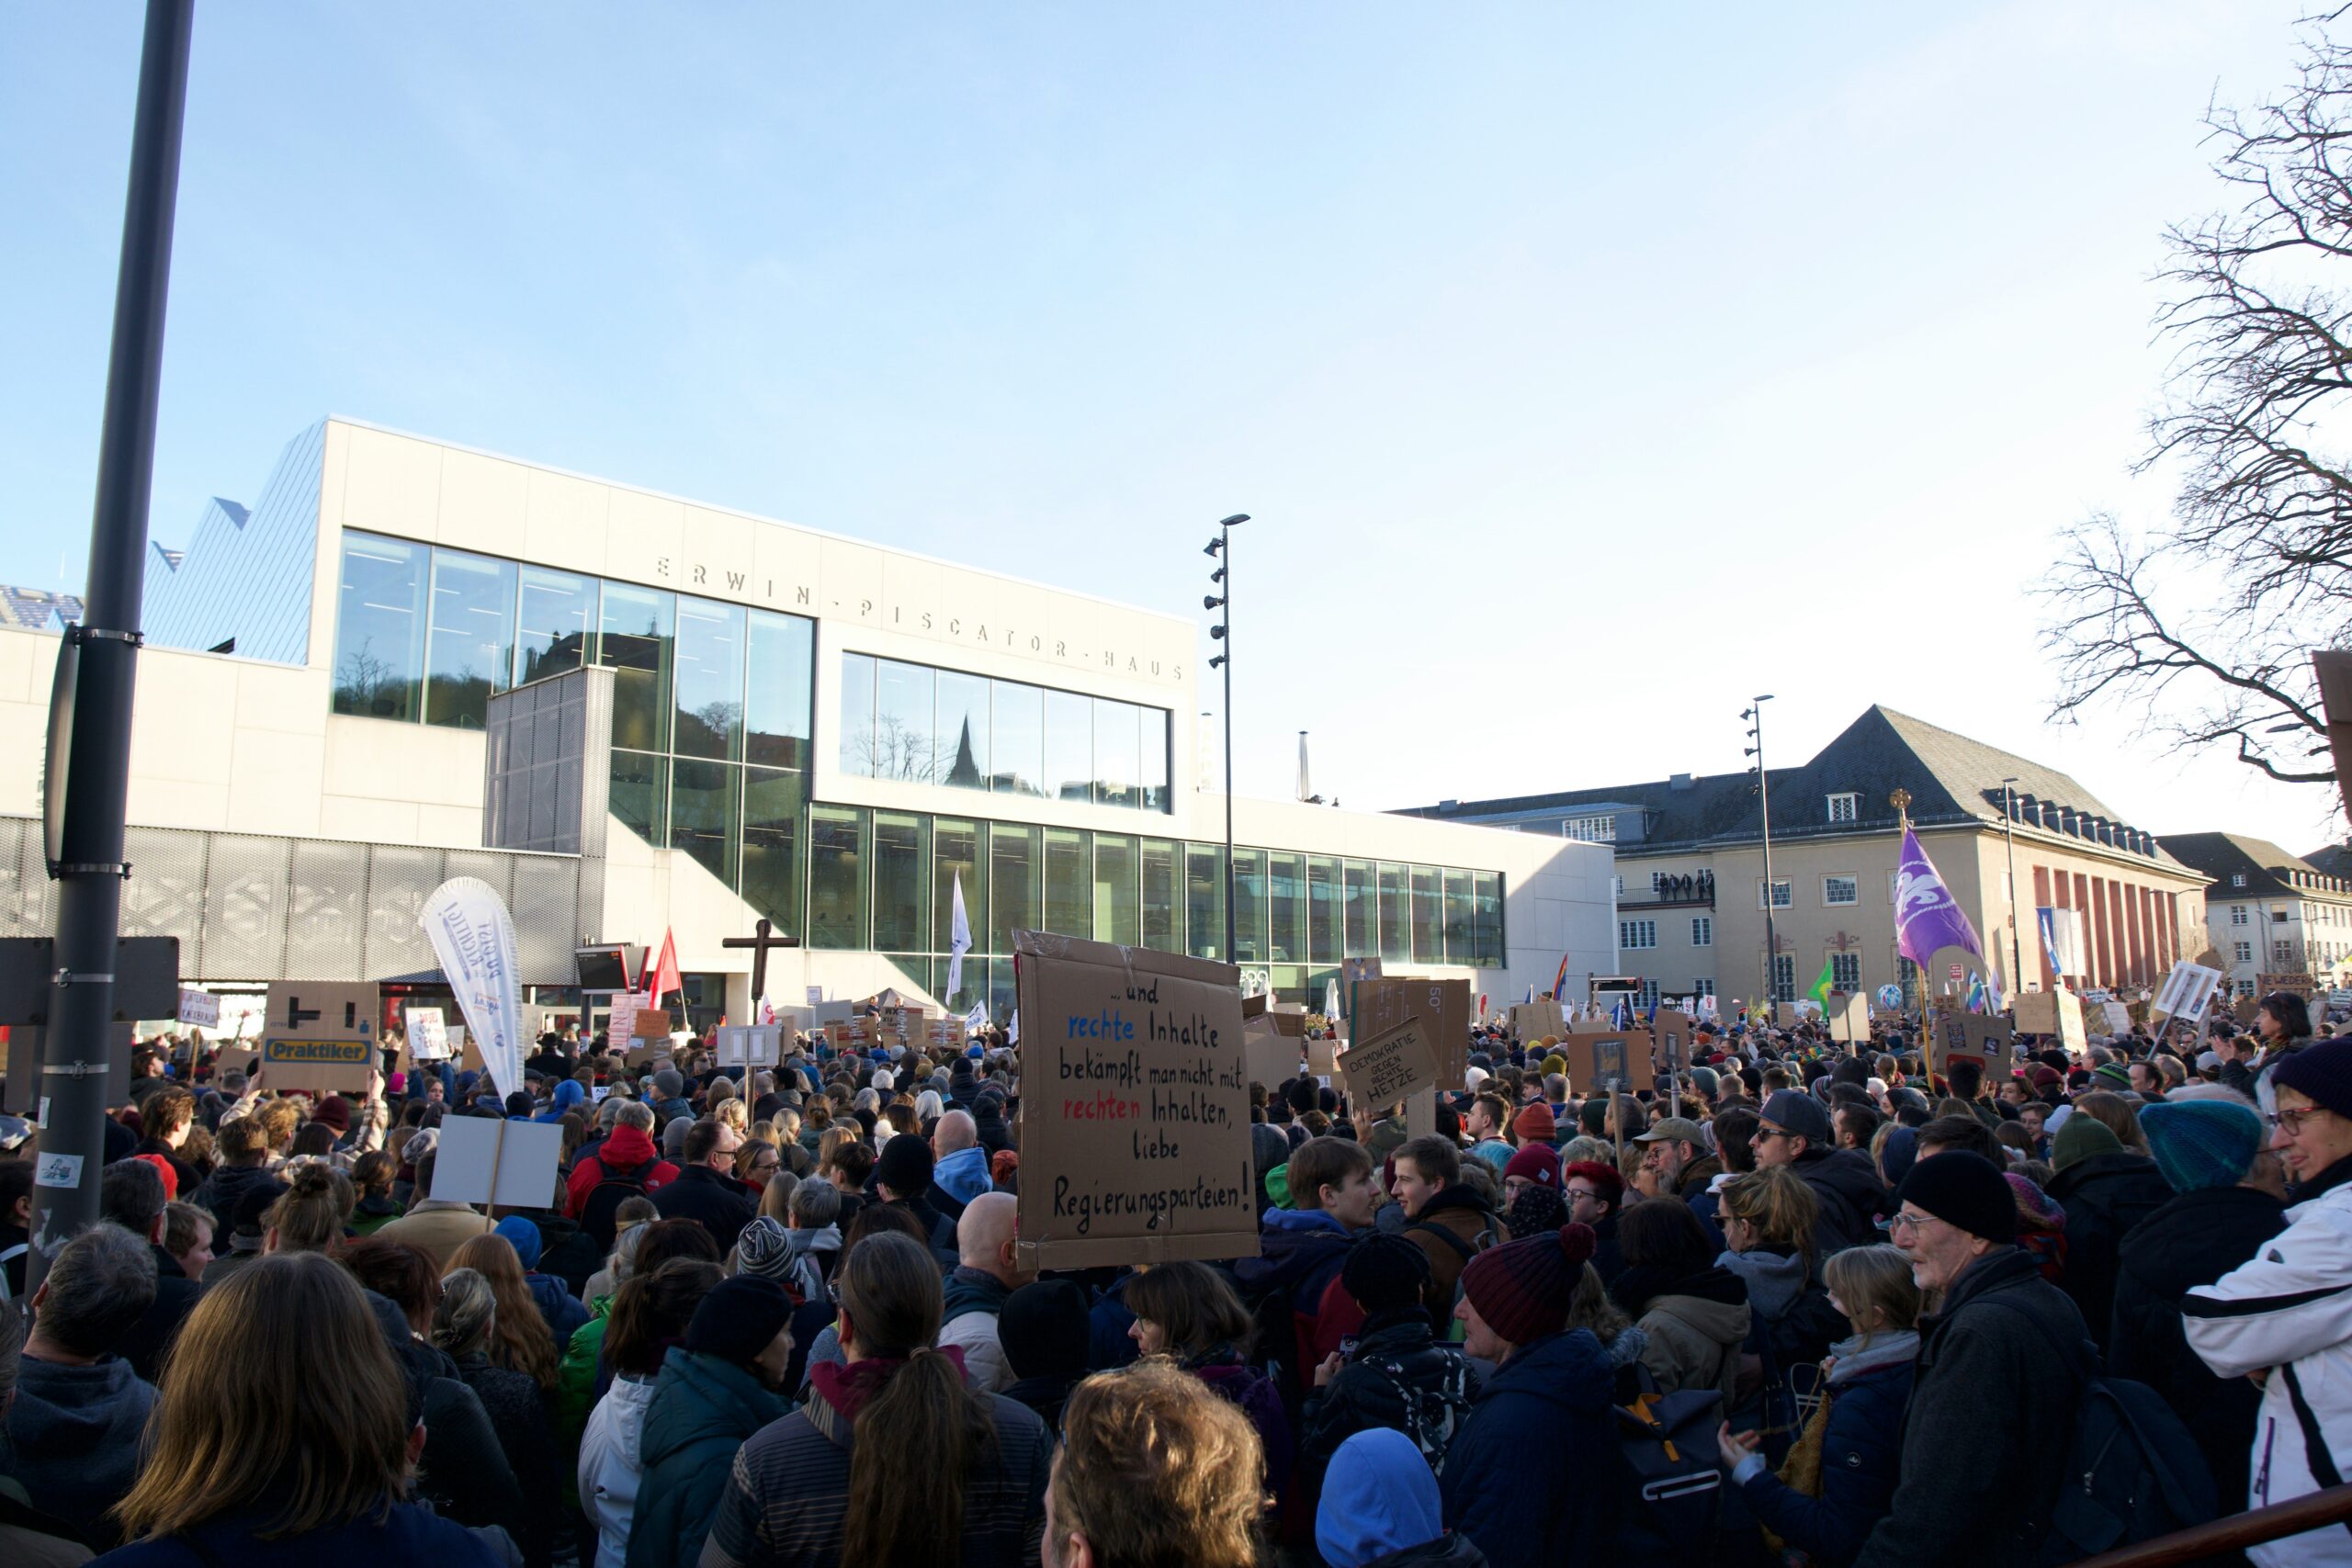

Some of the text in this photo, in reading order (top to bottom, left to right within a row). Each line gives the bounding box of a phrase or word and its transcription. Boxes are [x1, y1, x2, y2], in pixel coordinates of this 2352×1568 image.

[1126, 978, 1159, 1004] und
[1068, 1010, 1219, 1049] rechte Inhalte
[274, 1042, 363, 1059] Praktiker
[1349, 1032, 1417, 1073] DEMOKRATIE
[1371, 1055, 1402, 1075] GEGEN
[1060, 1047, 1242, 1090] bekämpft man nicht mit
[1366, 1067, 1419, 1102] HETZE
[1370, 1064, 1404, 1085] RECHTE
[1063, 1088, 1232, 1131] rechten Inhalten,
[1133, 1127, 1179, 1161] liebe
[1054, 1159, 1250, 1235] Regierungsparteien!
